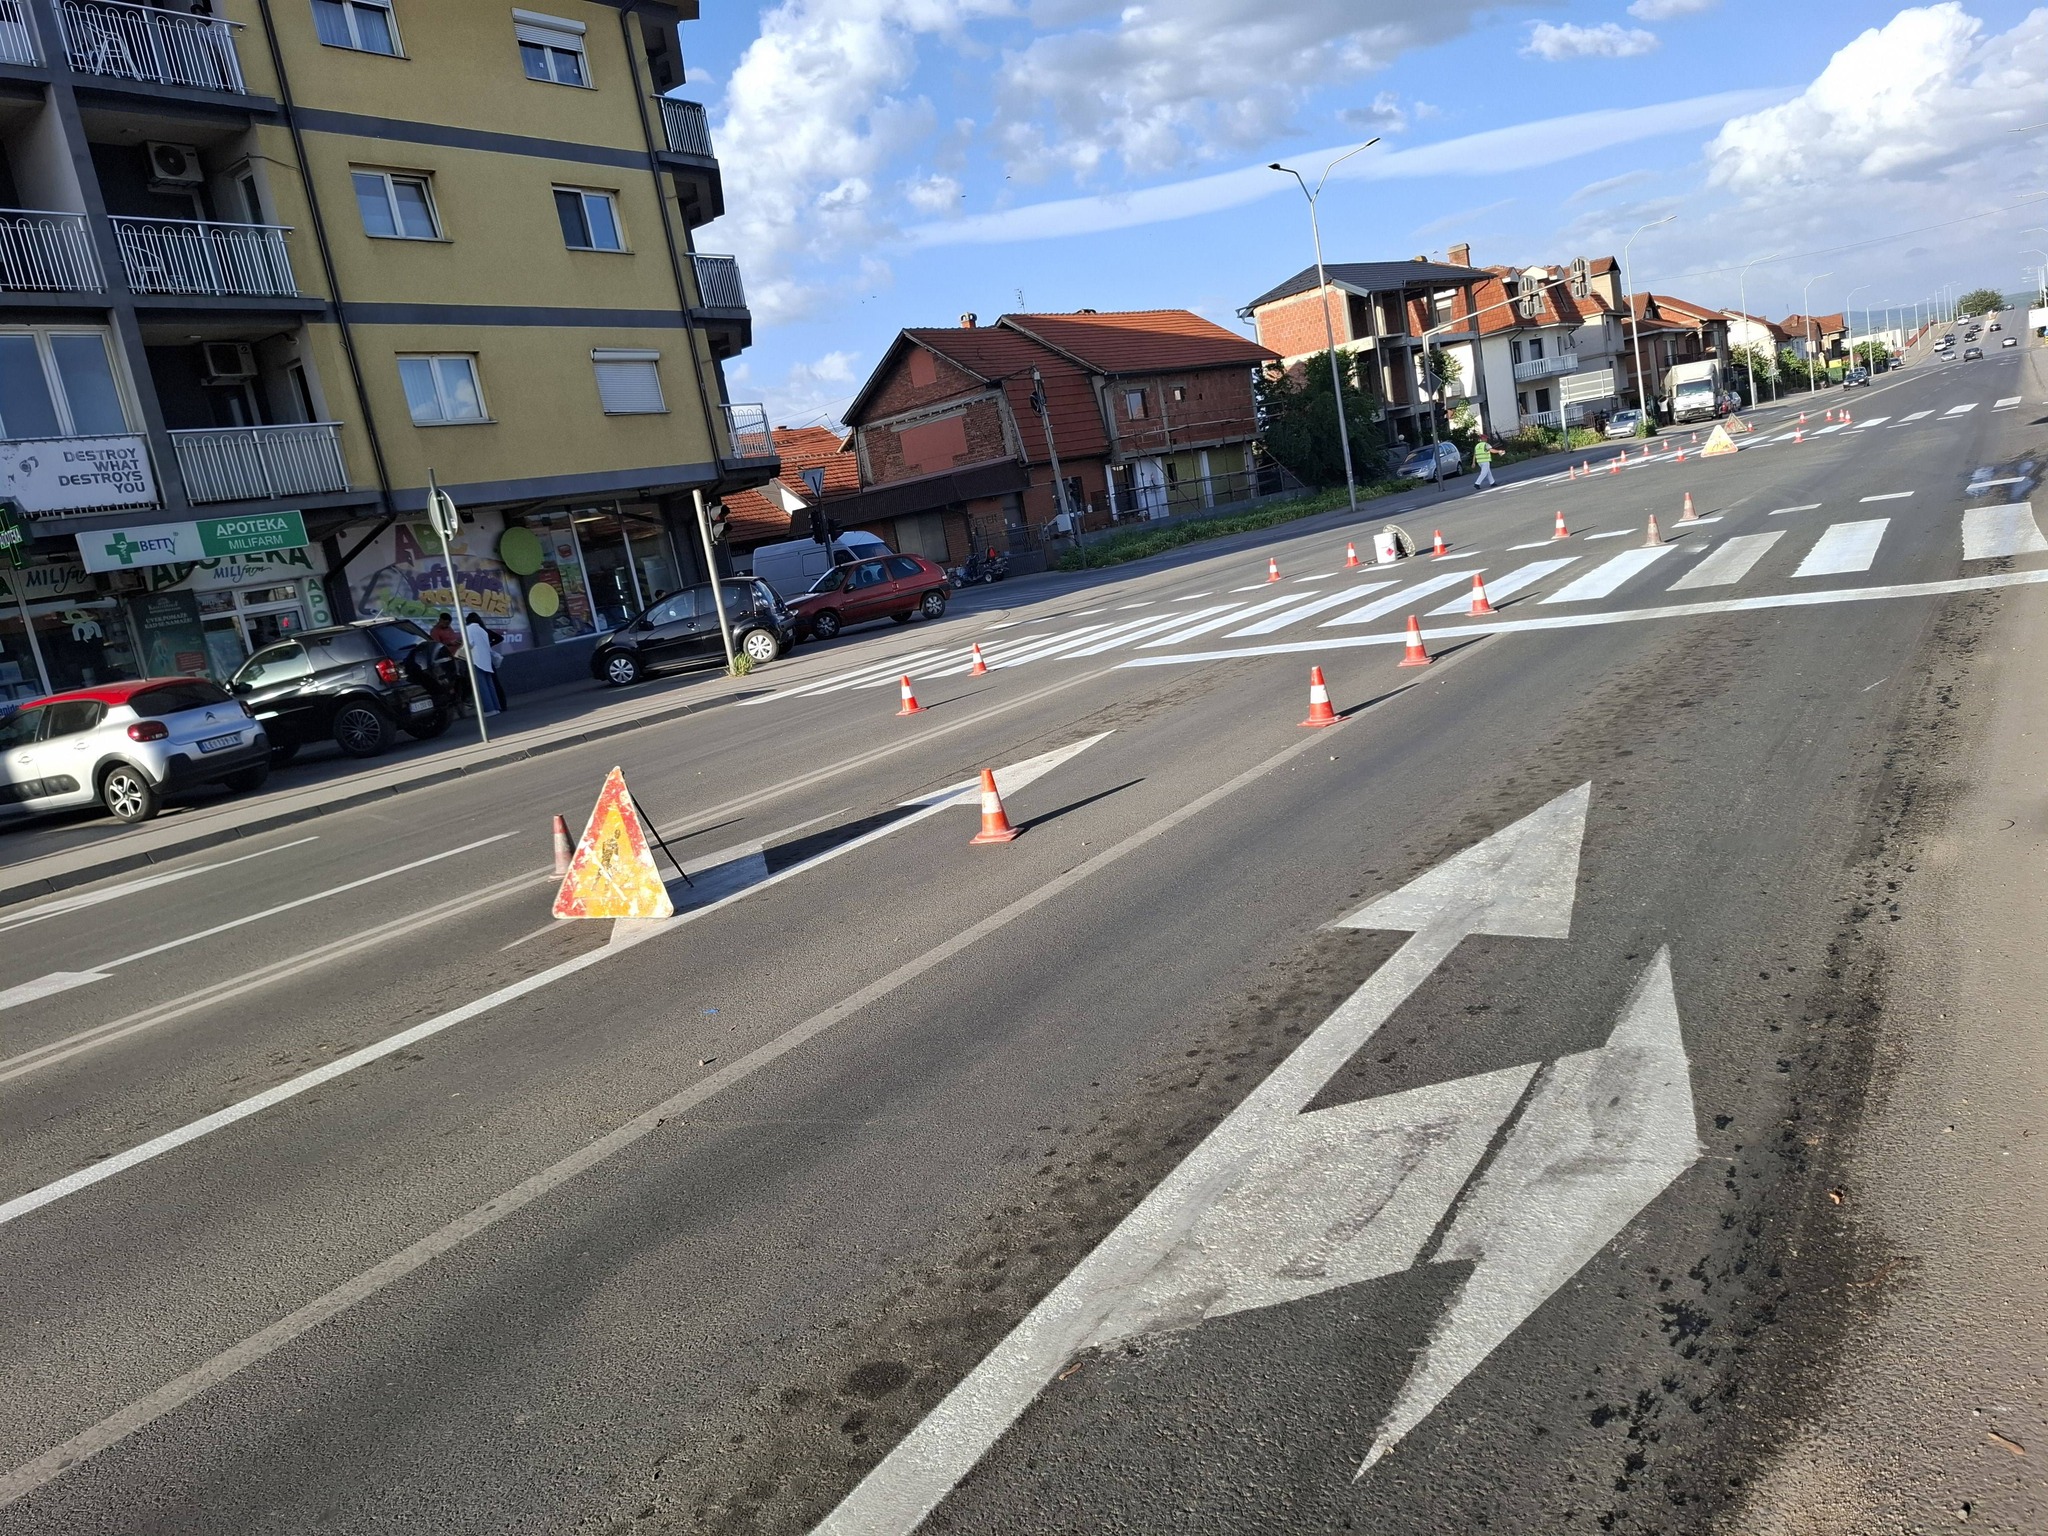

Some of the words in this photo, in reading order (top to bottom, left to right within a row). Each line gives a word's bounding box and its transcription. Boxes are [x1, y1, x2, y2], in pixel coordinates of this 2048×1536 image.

[63, 448, 136, 462] DESTROY
[93, 460, 139, 472] WHAT
[58, 471, 143, 486] DESTROYS
[114, 482, 146, 493] YOU
[217, 518, 288, 536] APOTEKA
[139, 537, 176, 555] BETTY
[229, 535, 283, 549] MILIFARM
